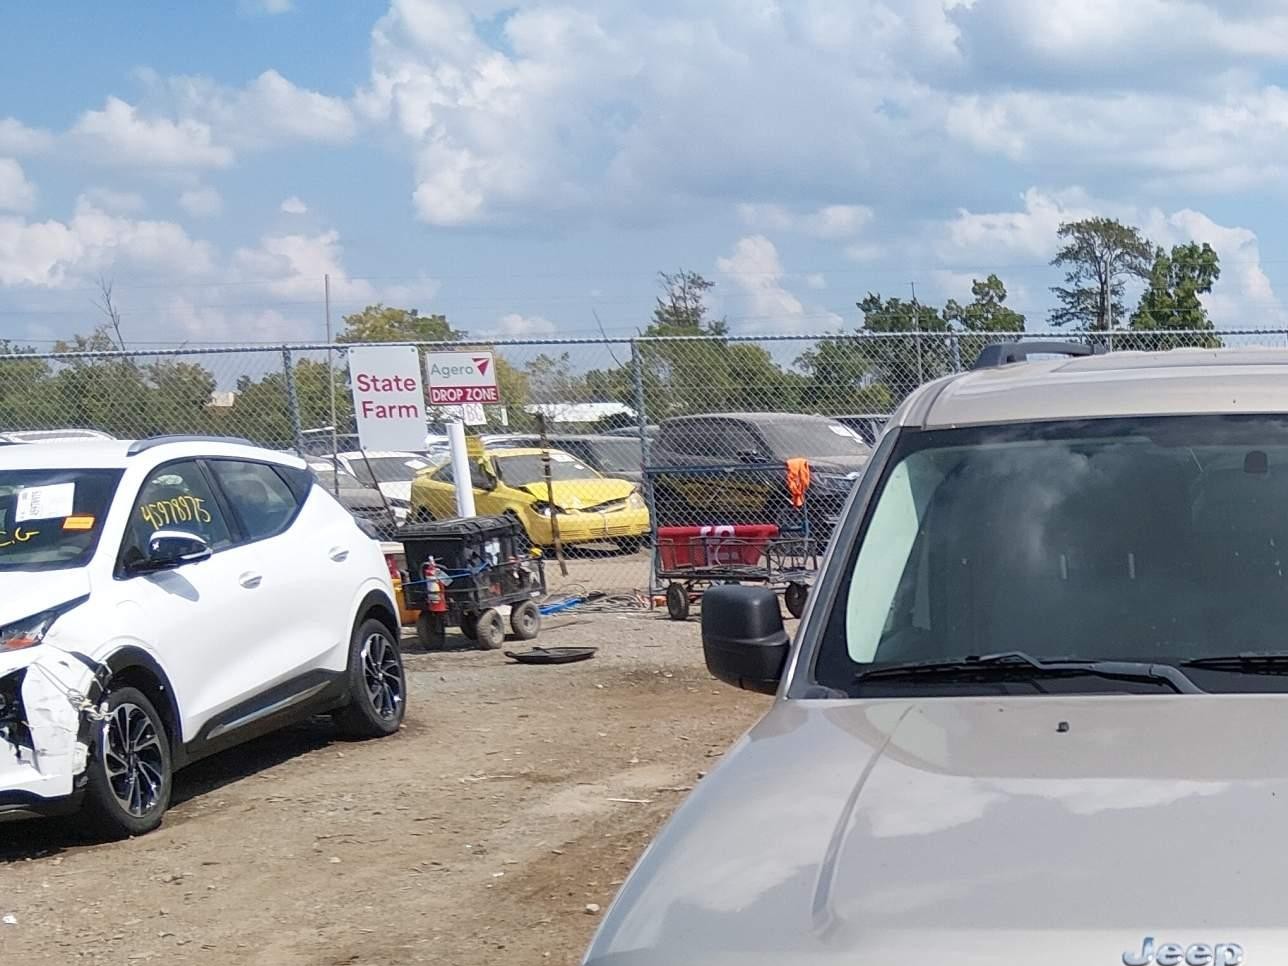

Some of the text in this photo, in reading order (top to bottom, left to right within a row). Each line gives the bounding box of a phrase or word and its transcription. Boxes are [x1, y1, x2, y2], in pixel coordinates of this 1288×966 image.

[431, 363, 474, 379] Agero
[356, 373, 417, 392] State
[431, 387, 498, 402] DROP ZONE
[362, 400, 419, 419] Farm
[140, 495, 211, 530] 45978975
